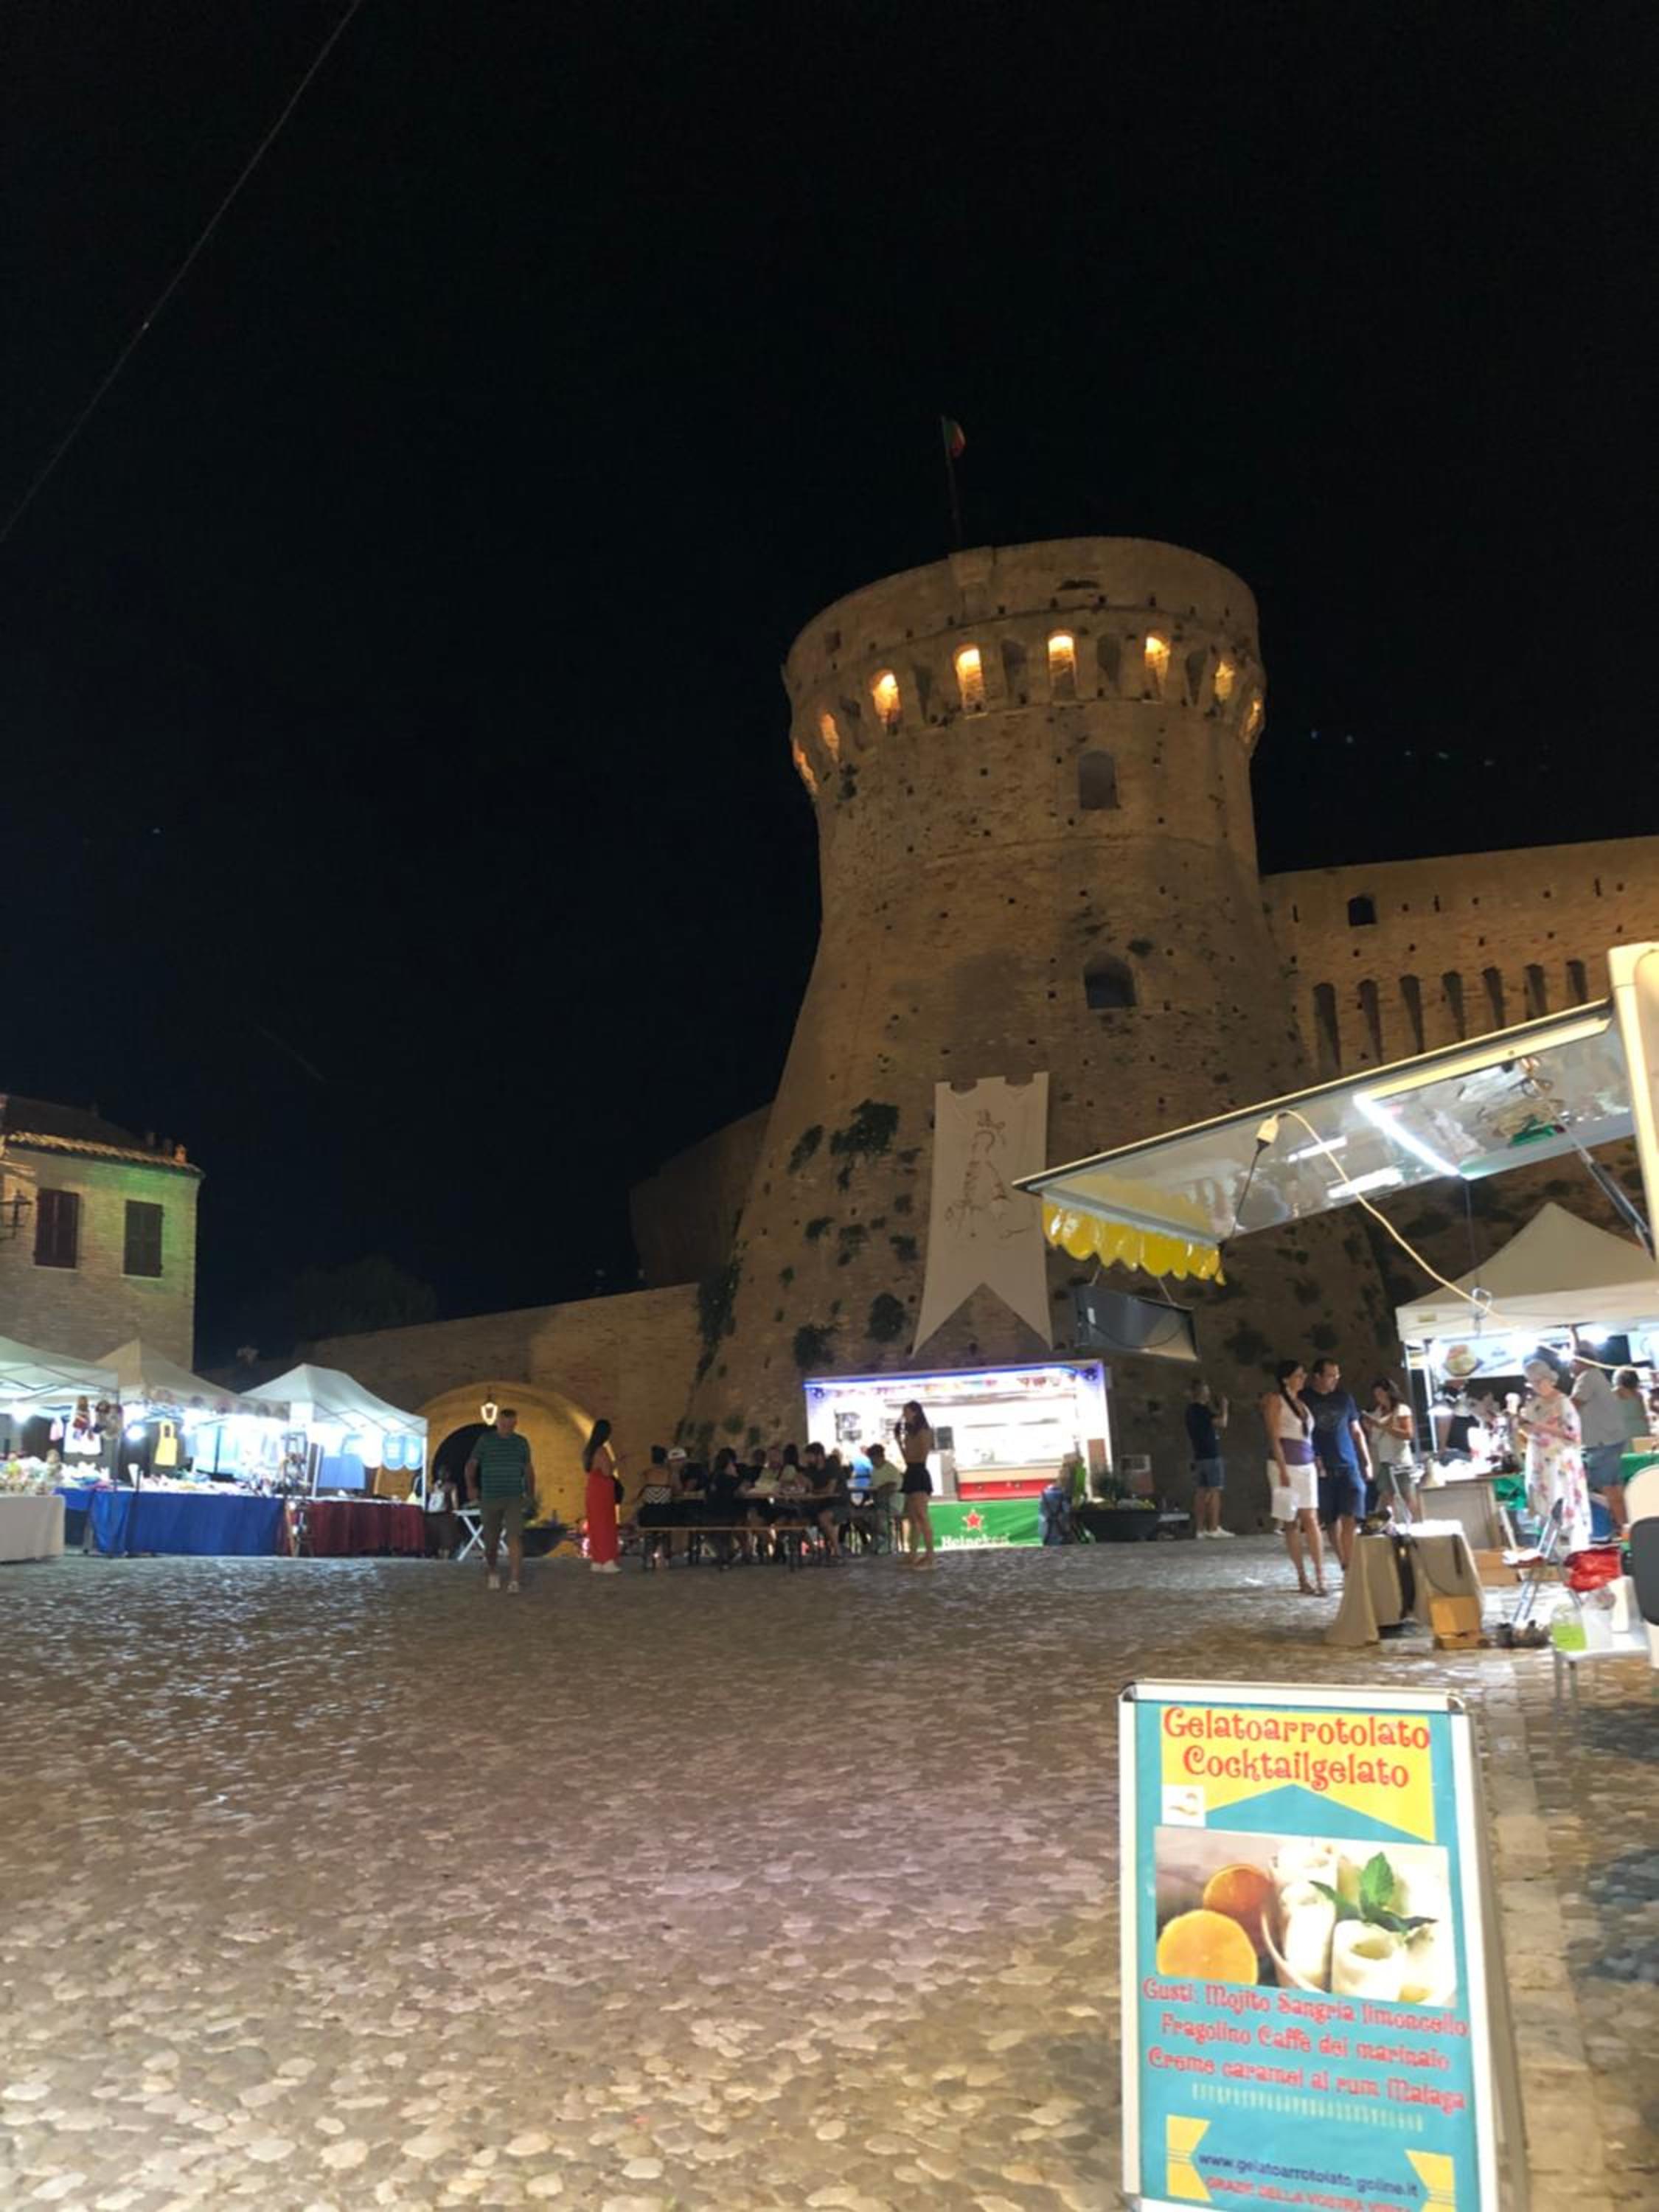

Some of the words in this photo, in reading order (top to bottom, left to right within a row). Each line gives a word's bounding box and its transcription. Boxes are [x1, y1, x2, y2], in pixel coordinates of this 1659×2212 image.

[1164, 1706, 1431, 1749] Gelatoarrotolato
[1183, 1745, 1410, 1791] Cocktailgelato
[1205, 1983, 1270, 2014] Mojito
[1277, 1992, 1355, 2024] Sangria
[1161, 2013, 1251, 2045] Fragolino
[1222, 2062, 1304, 2086] caramel
[1310, 2069, 1329, 2091] al
[1336, 2076, 1380, 2096] rum
[1387, 2078, 1466, 2114] Malaga
